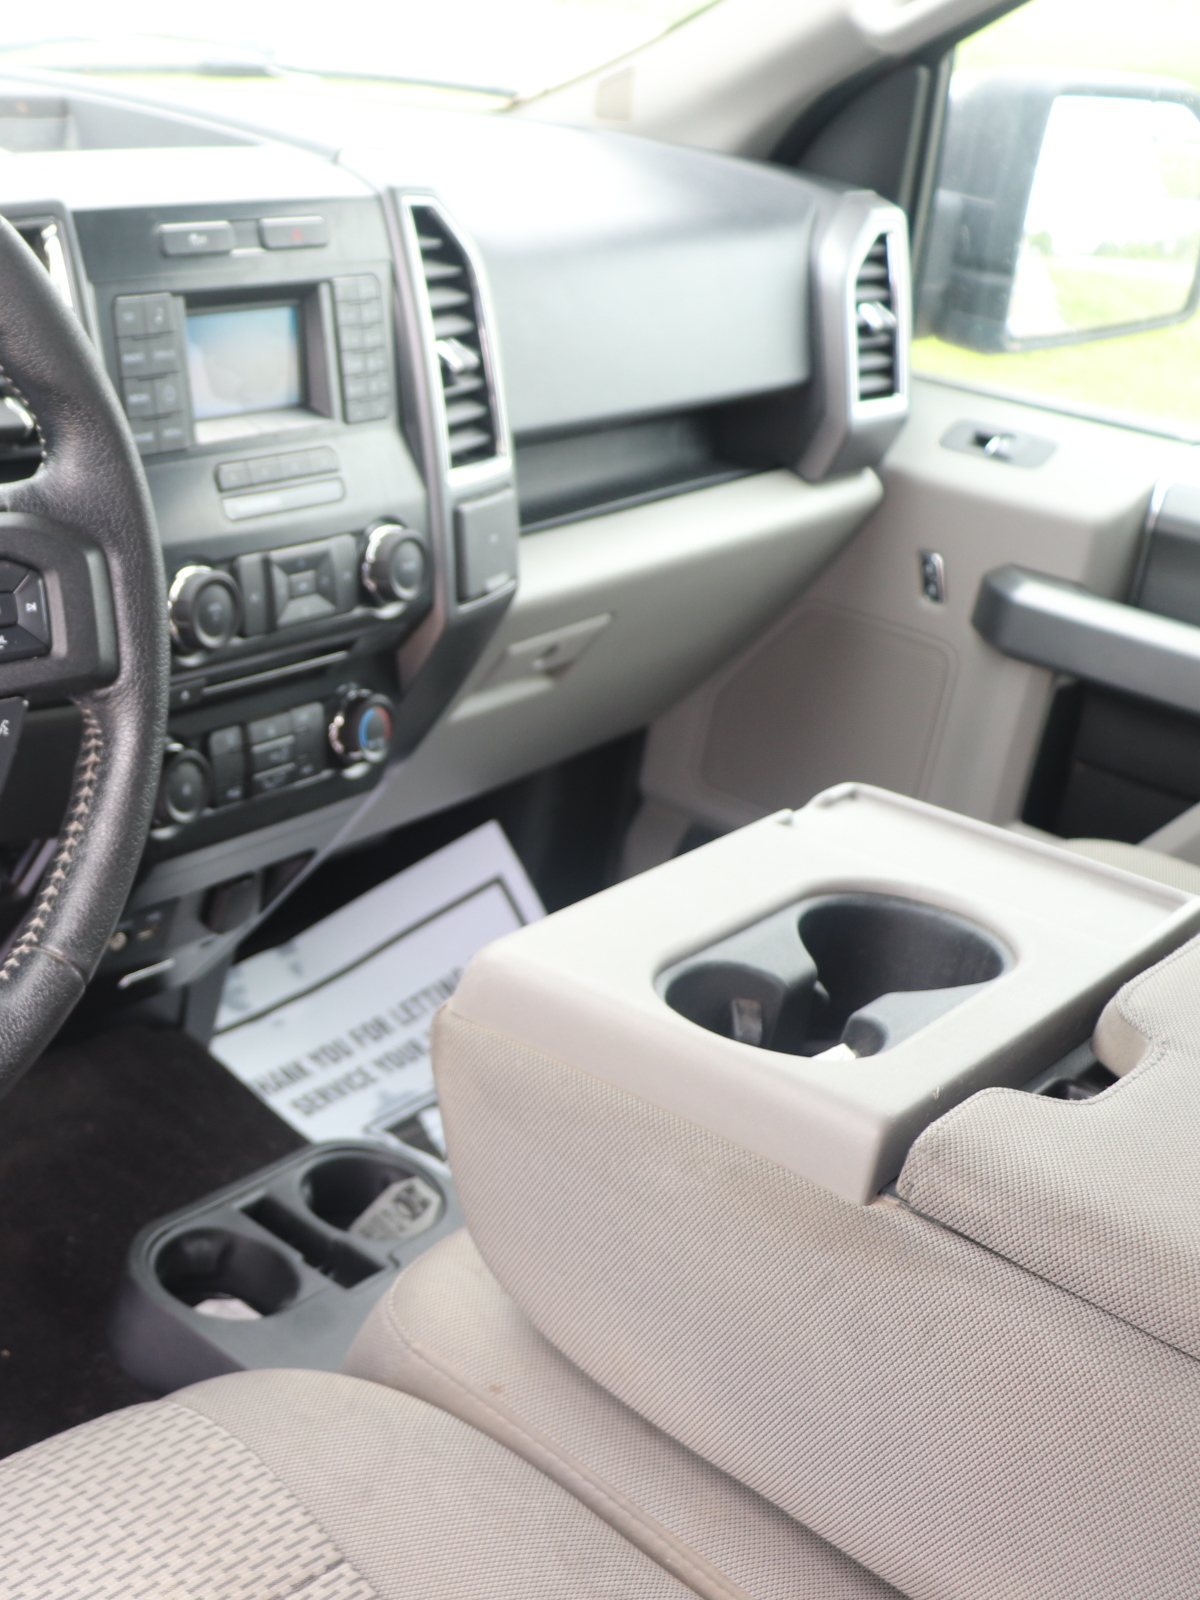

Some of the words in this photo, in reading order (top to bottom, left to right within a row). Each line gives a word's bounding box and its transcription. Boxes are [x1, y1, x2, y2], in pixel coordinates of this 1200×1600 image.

[252, 1059, 310, 1096] HANK
[307, 1036, 355, 1068] YOU
[348, 1015, 394, 1047] FOR
